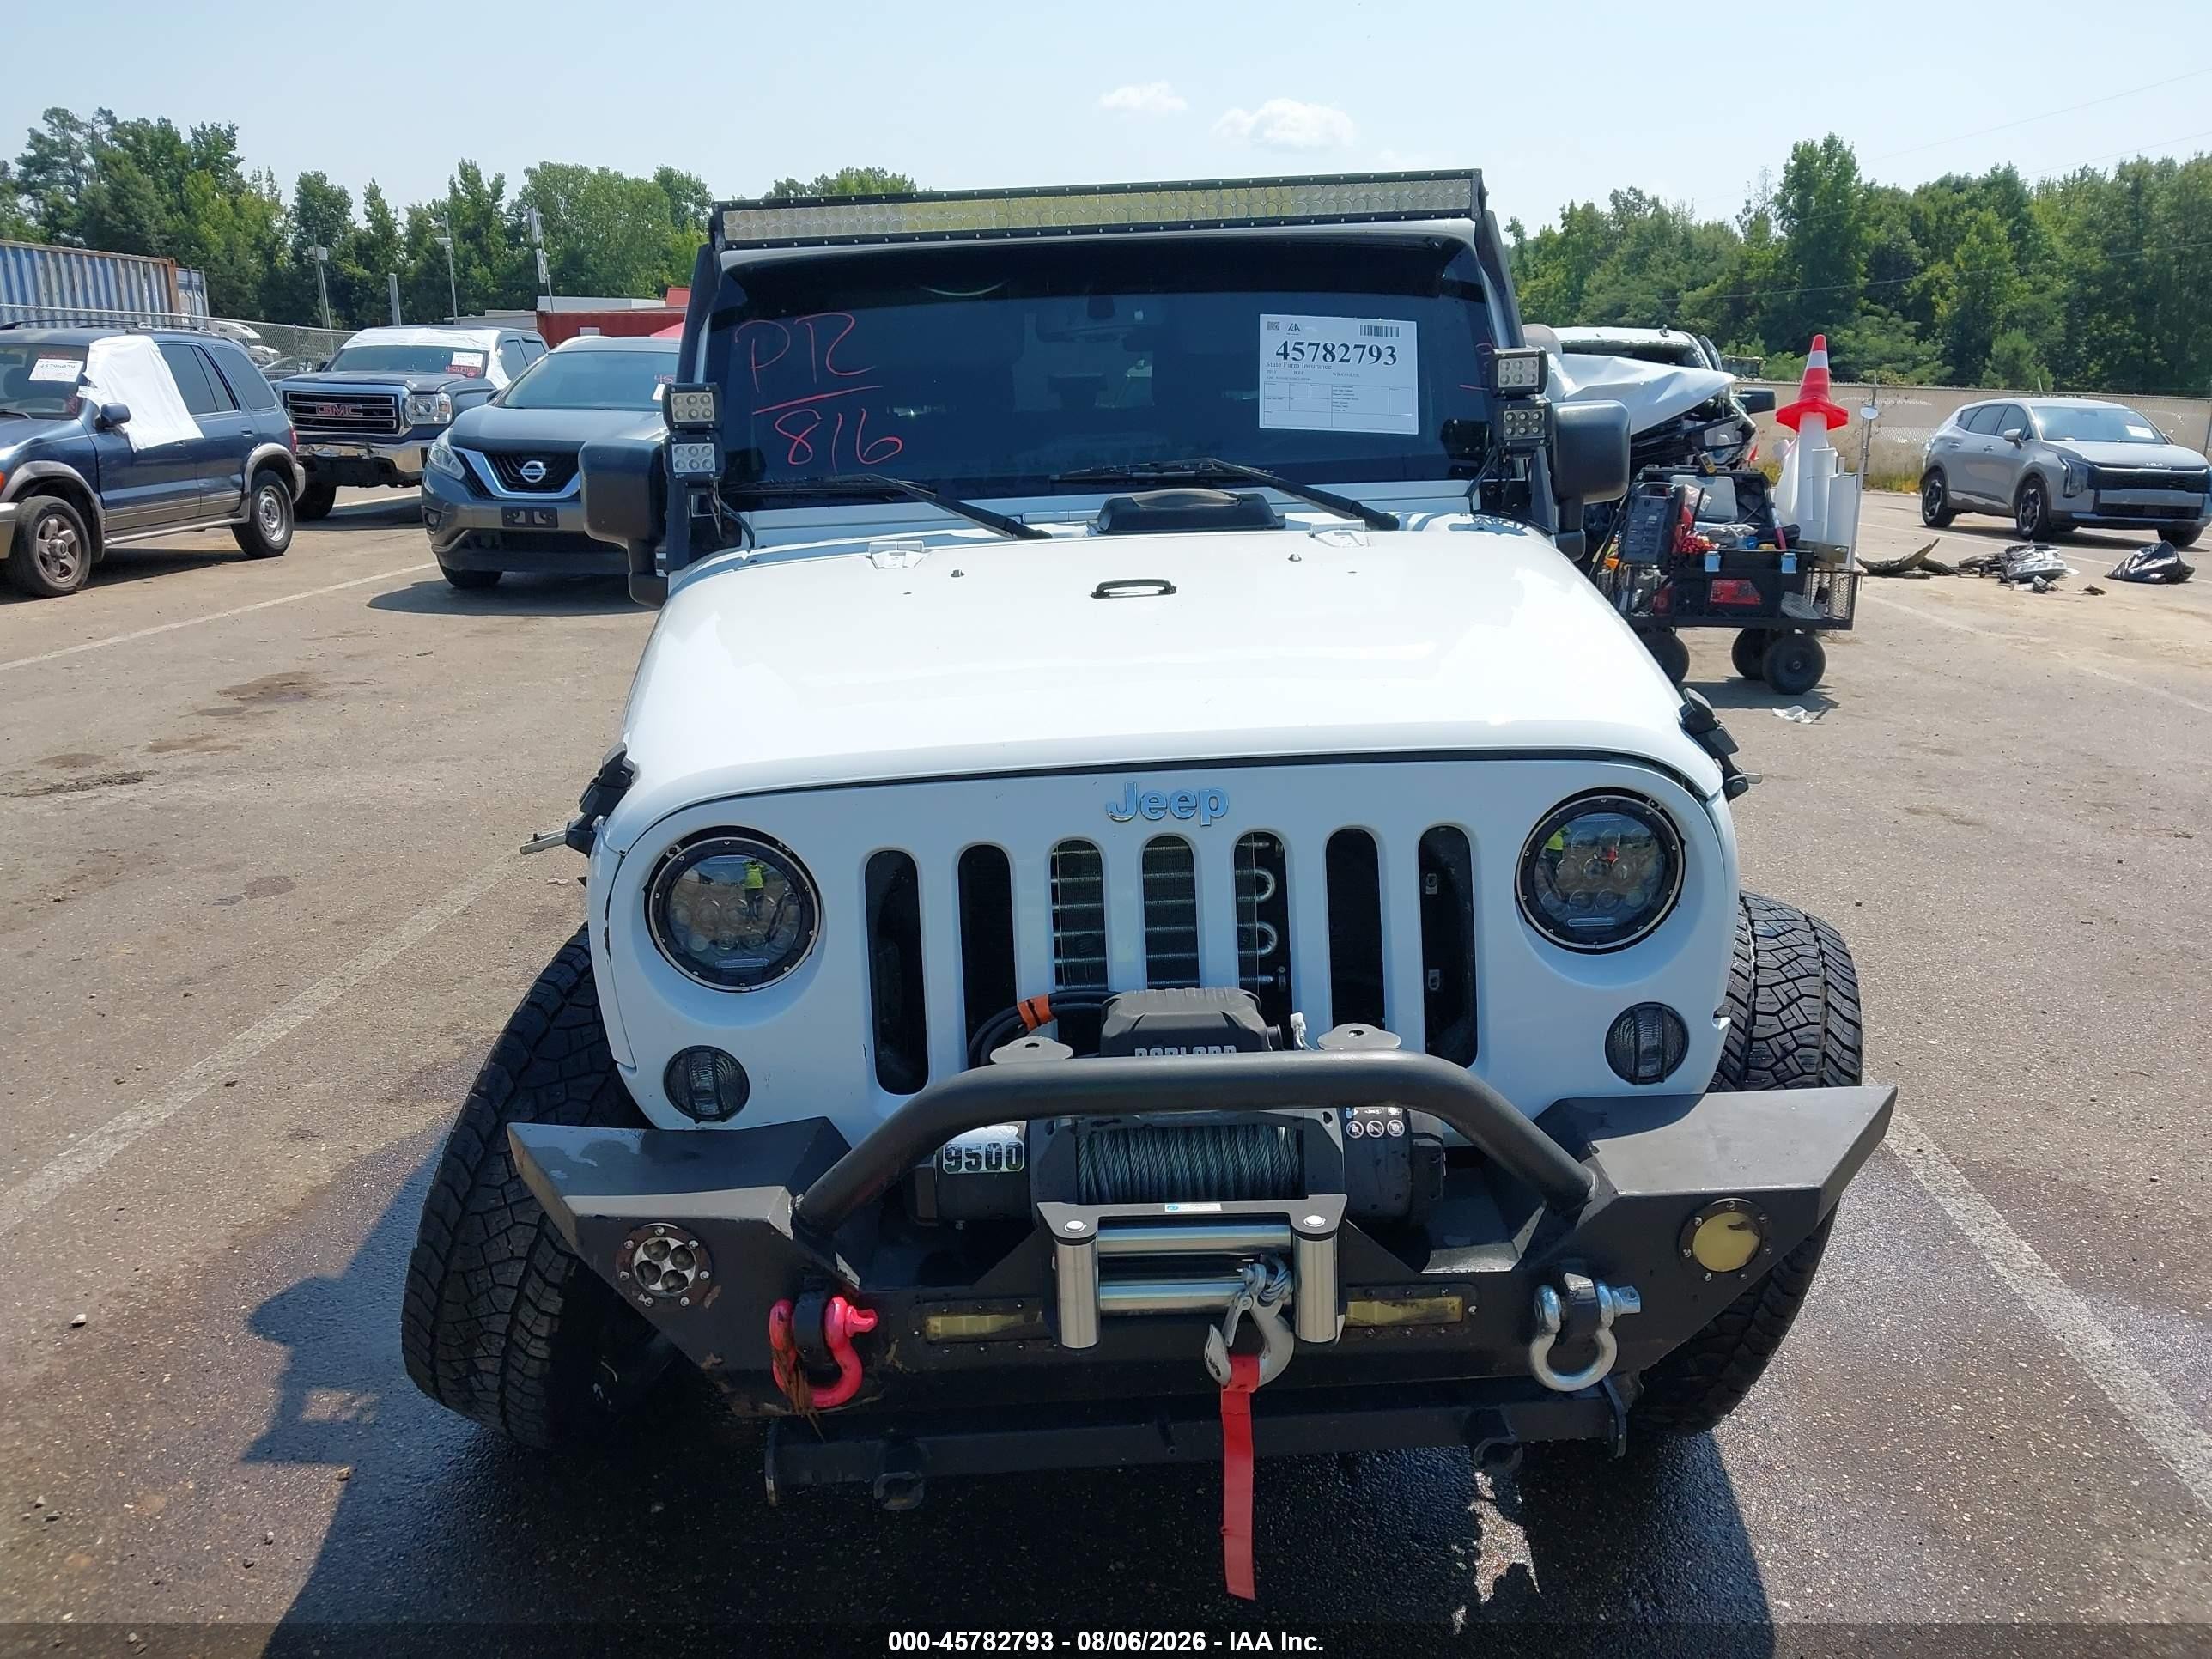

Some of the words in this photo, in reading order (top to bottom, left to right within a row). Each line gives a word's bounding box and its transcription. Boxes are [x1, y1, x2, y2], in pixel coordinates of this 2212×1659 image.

[1275, 340, 1398, 367] 45782793
[1301, 362, 1333, 371] Insurance
[316, 404, 363, 416] GMC
[1105, 781, 1229, 827] Jeep
[943, 1142, 1024, 1174] 9500
